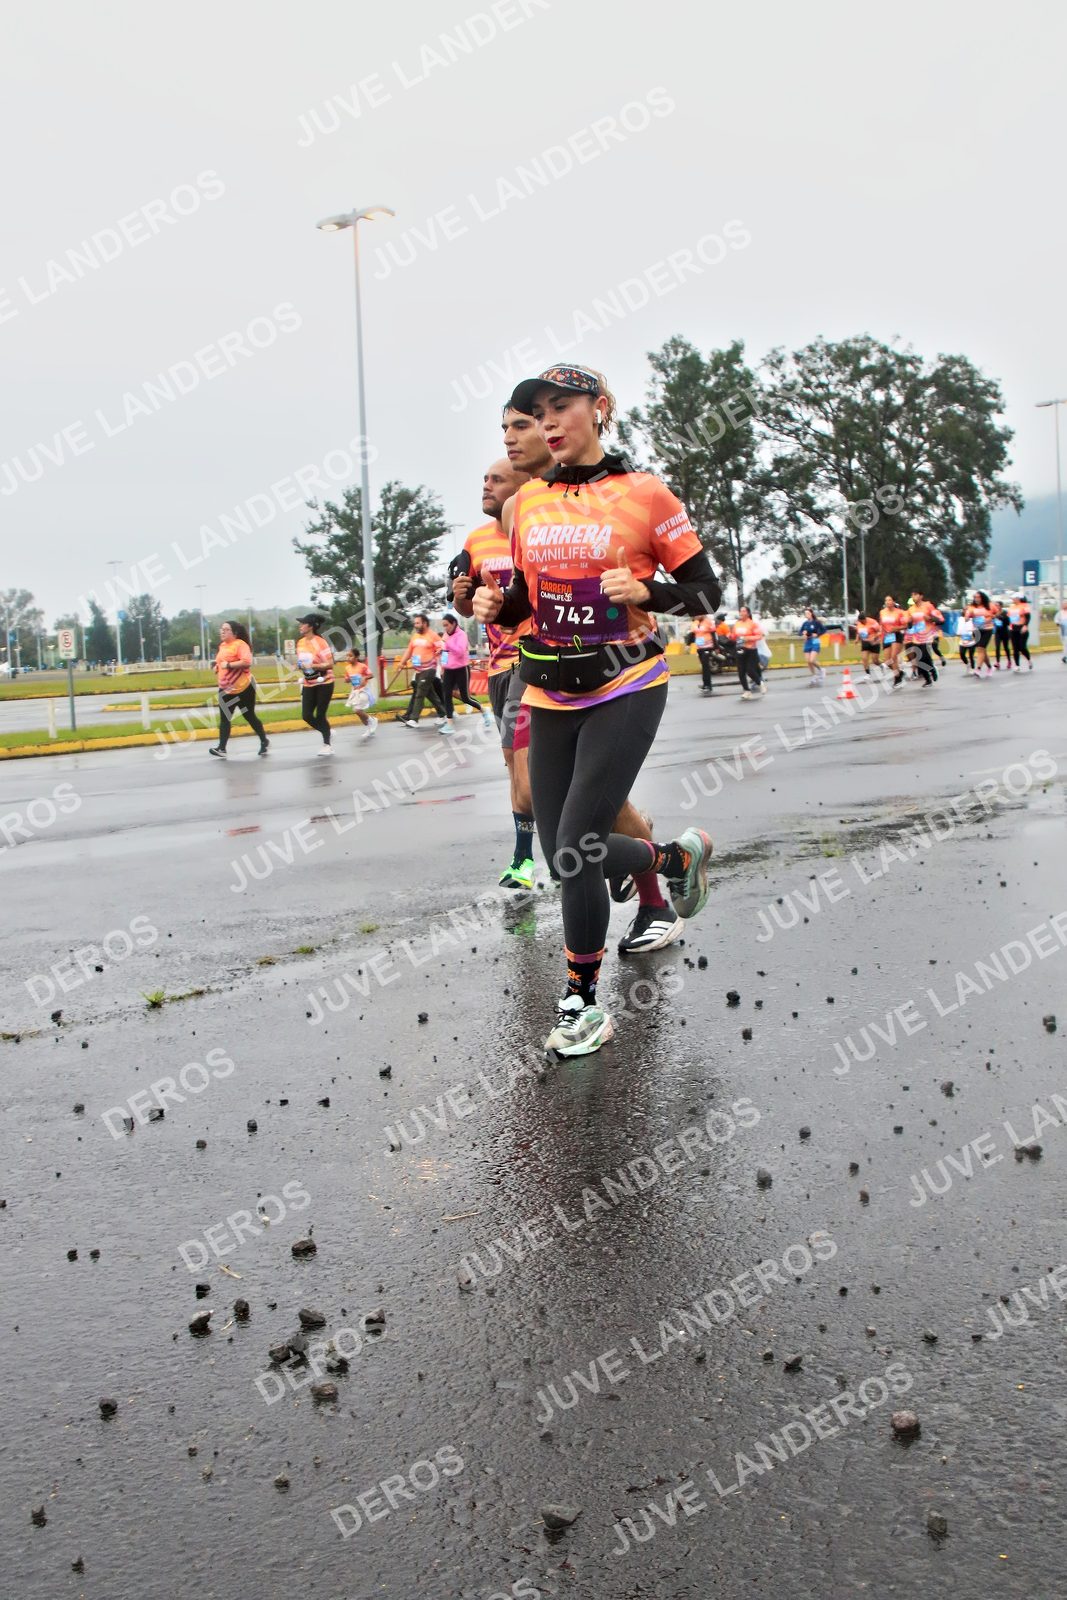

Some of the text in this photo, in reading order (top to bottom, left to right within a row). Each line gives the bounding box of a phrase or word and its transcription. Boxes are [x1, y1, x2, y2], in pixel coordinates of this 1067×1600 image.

[527, 524, 613, 546] CARRERA
[527, 546, 587, 562] OMNILIFE
[1026, 571, 1036, 584] E
[541, 580, 573, 594] CARRERA
[554, 605, 595, 624] 742
